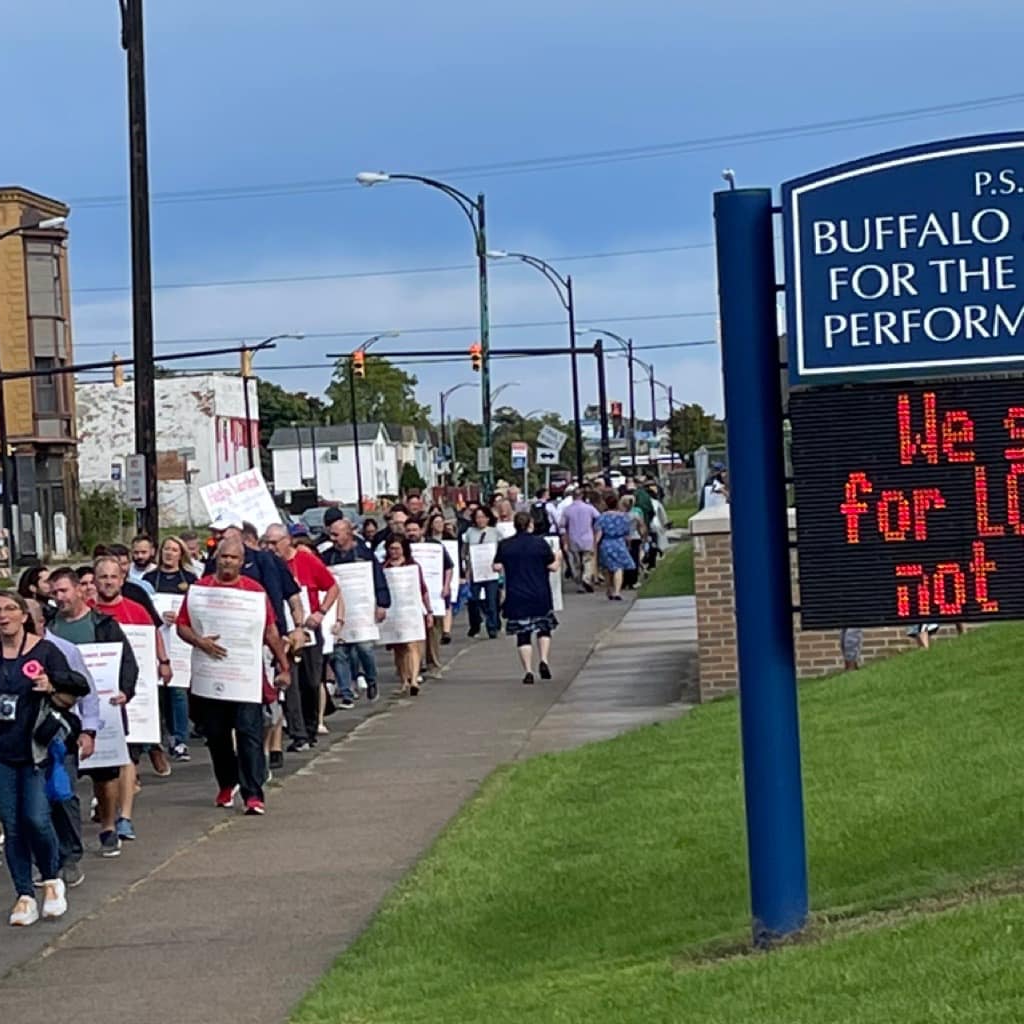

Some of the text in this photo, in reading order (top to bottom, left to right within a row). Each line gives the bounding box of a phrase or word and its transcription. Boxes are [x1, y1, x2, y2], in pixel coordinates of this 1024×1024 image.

[813, 208, 1010, 255] BUFFALO
[829, 255, 1017, 301] FOR THE
[897, 392, 976, 465] We
[839, 471, 947, 544] for
[895, 540, 1000, 618] not
